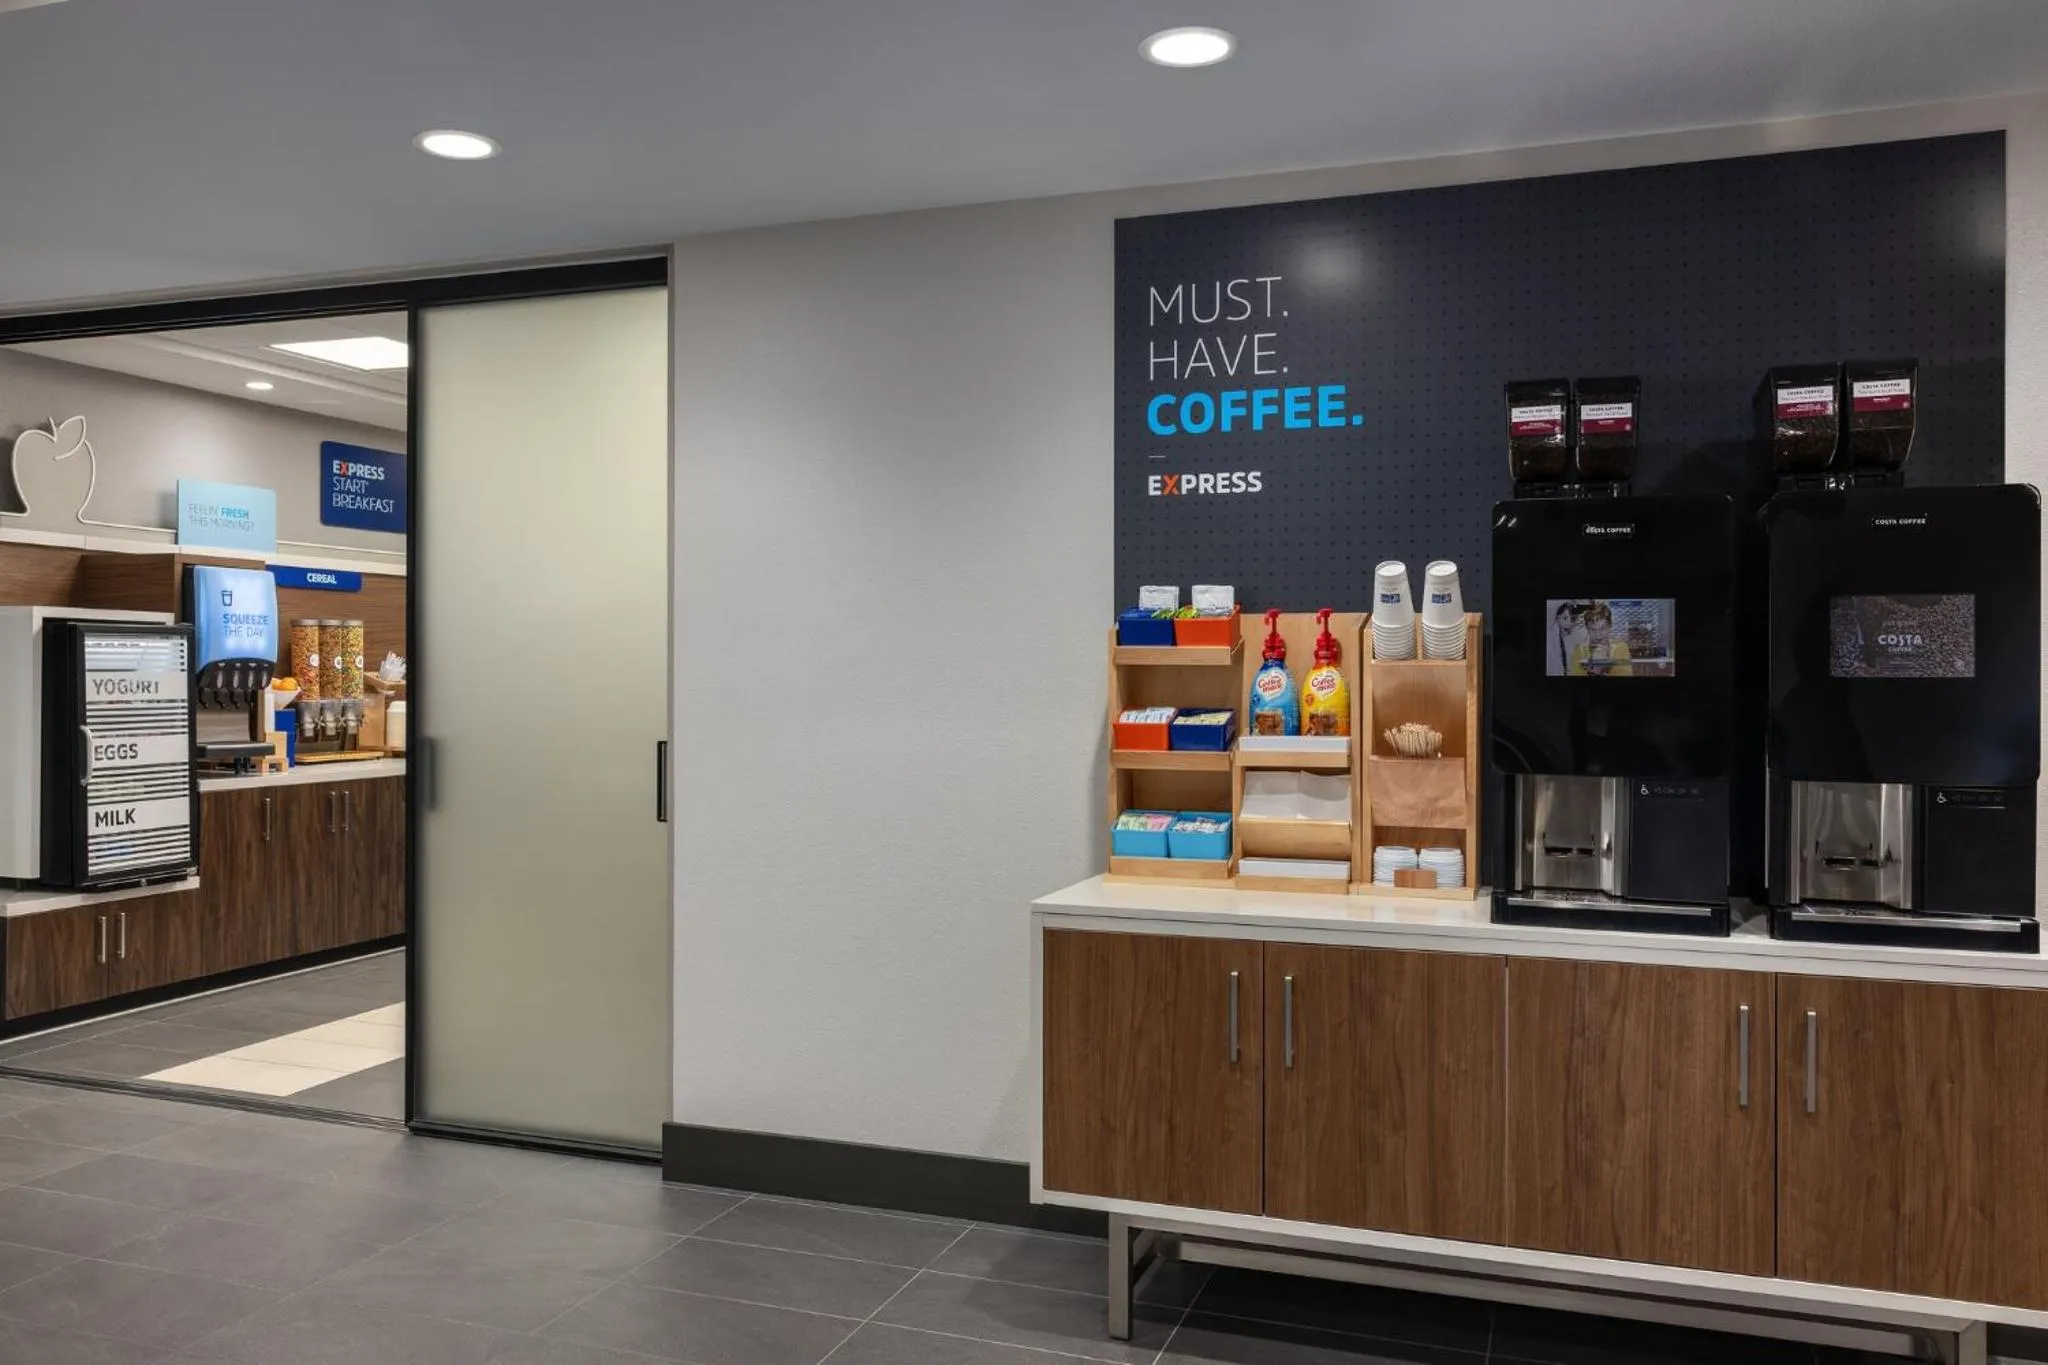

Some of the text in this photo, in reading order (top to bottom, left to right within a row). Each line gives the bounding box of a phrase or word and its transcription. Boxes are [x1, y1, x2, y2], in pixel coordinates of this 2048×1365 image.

[1150, 276, 1288, 327] MUST.
[1150, 332, 1288, 381] HAVE.
[1147, 385, 1364, 436] COFFEE.
[332, 459, 385, 480] EXPRESS
[1148, 471, 1263, 496] EXPRESS
[332, 492, 395, 513] BREAKFAST
[220, 507, 249, 519] FRESH
[307, 572, 337, 585] CEREAL
[222, 613, 268, 625] SQUEEZE
[1878, 634, 1922, 646] COSTA
[92, 679, 160, 696] YOGURT
[94, 744, 138, 761] EGGS
[95, 808, 136, 827] MILK
